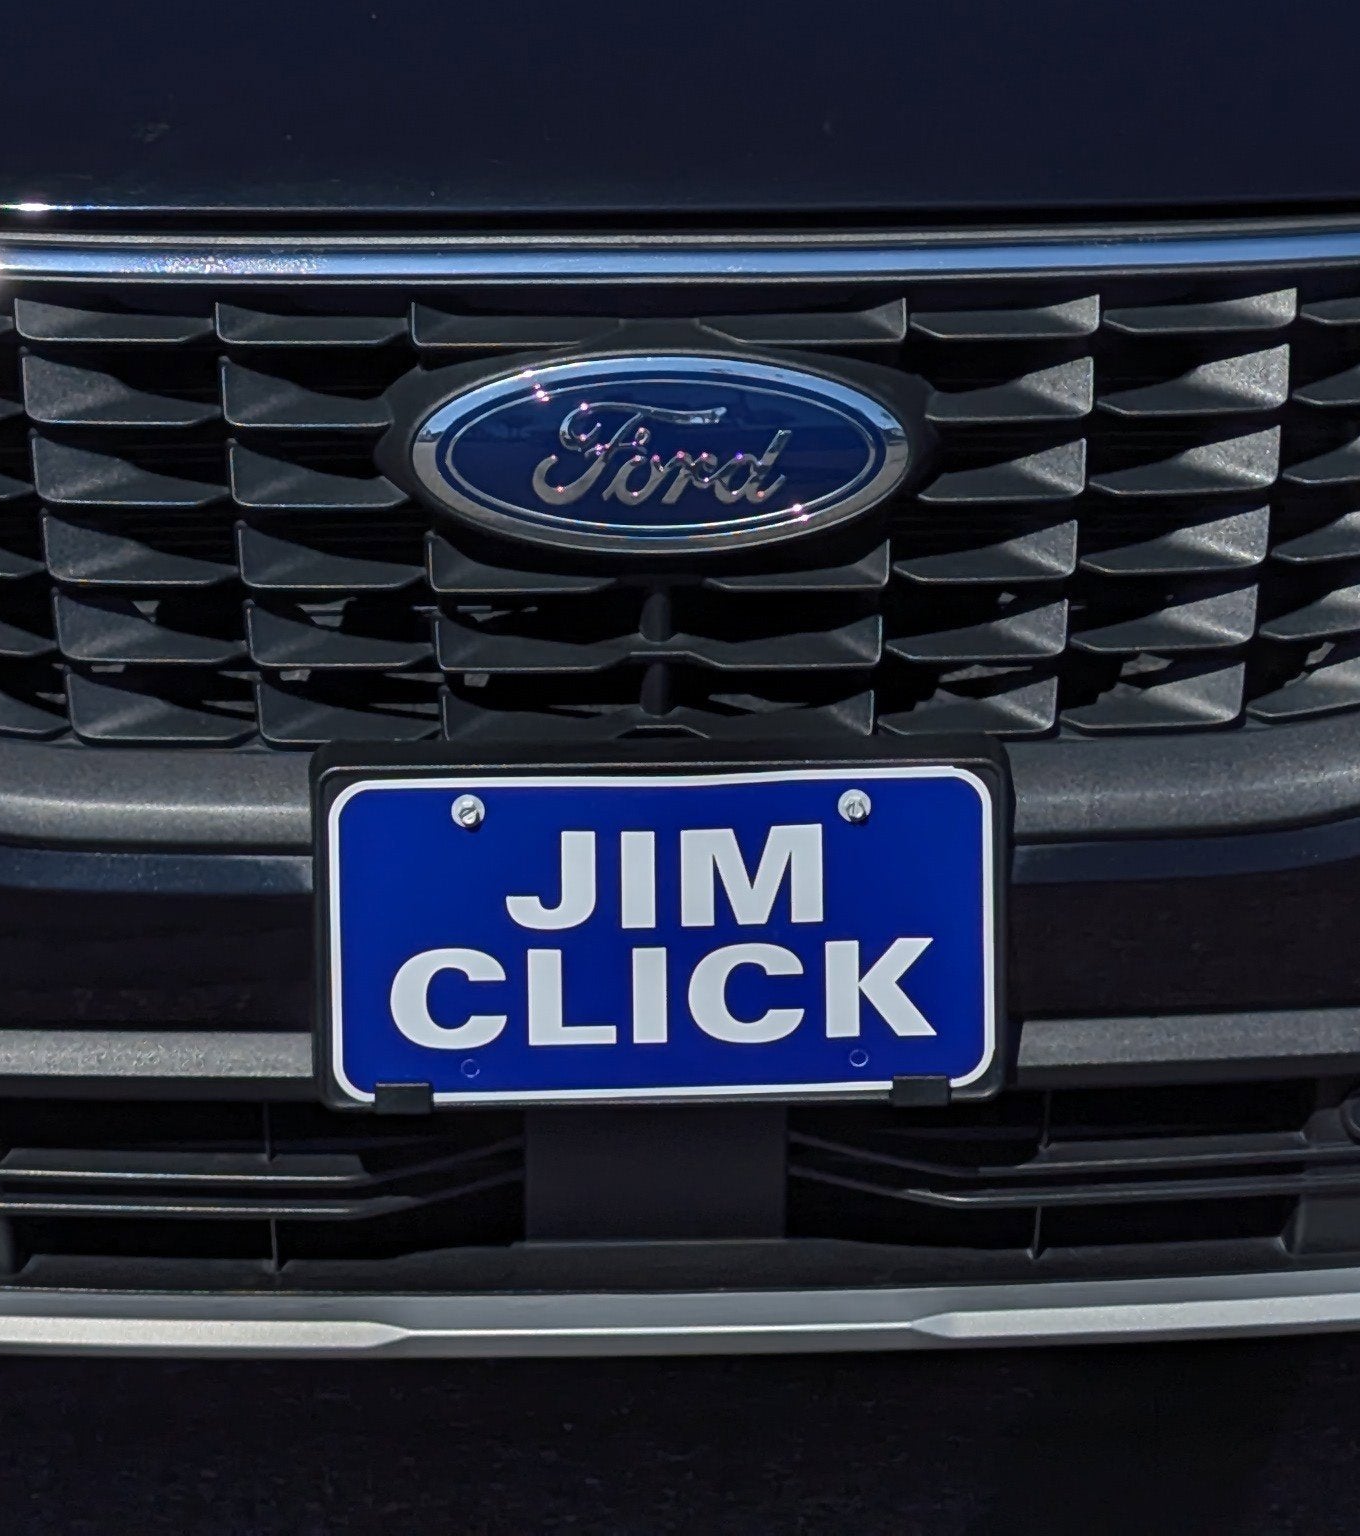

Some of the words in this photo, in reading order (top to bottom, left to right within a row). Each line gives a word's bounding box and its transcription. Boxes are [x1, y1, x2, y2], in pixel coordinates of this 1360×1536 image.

[531, 401, 793, 505] Ford
[505, 823, 824, 930] JIM
[389, 936, 938, 1050] CLICK
